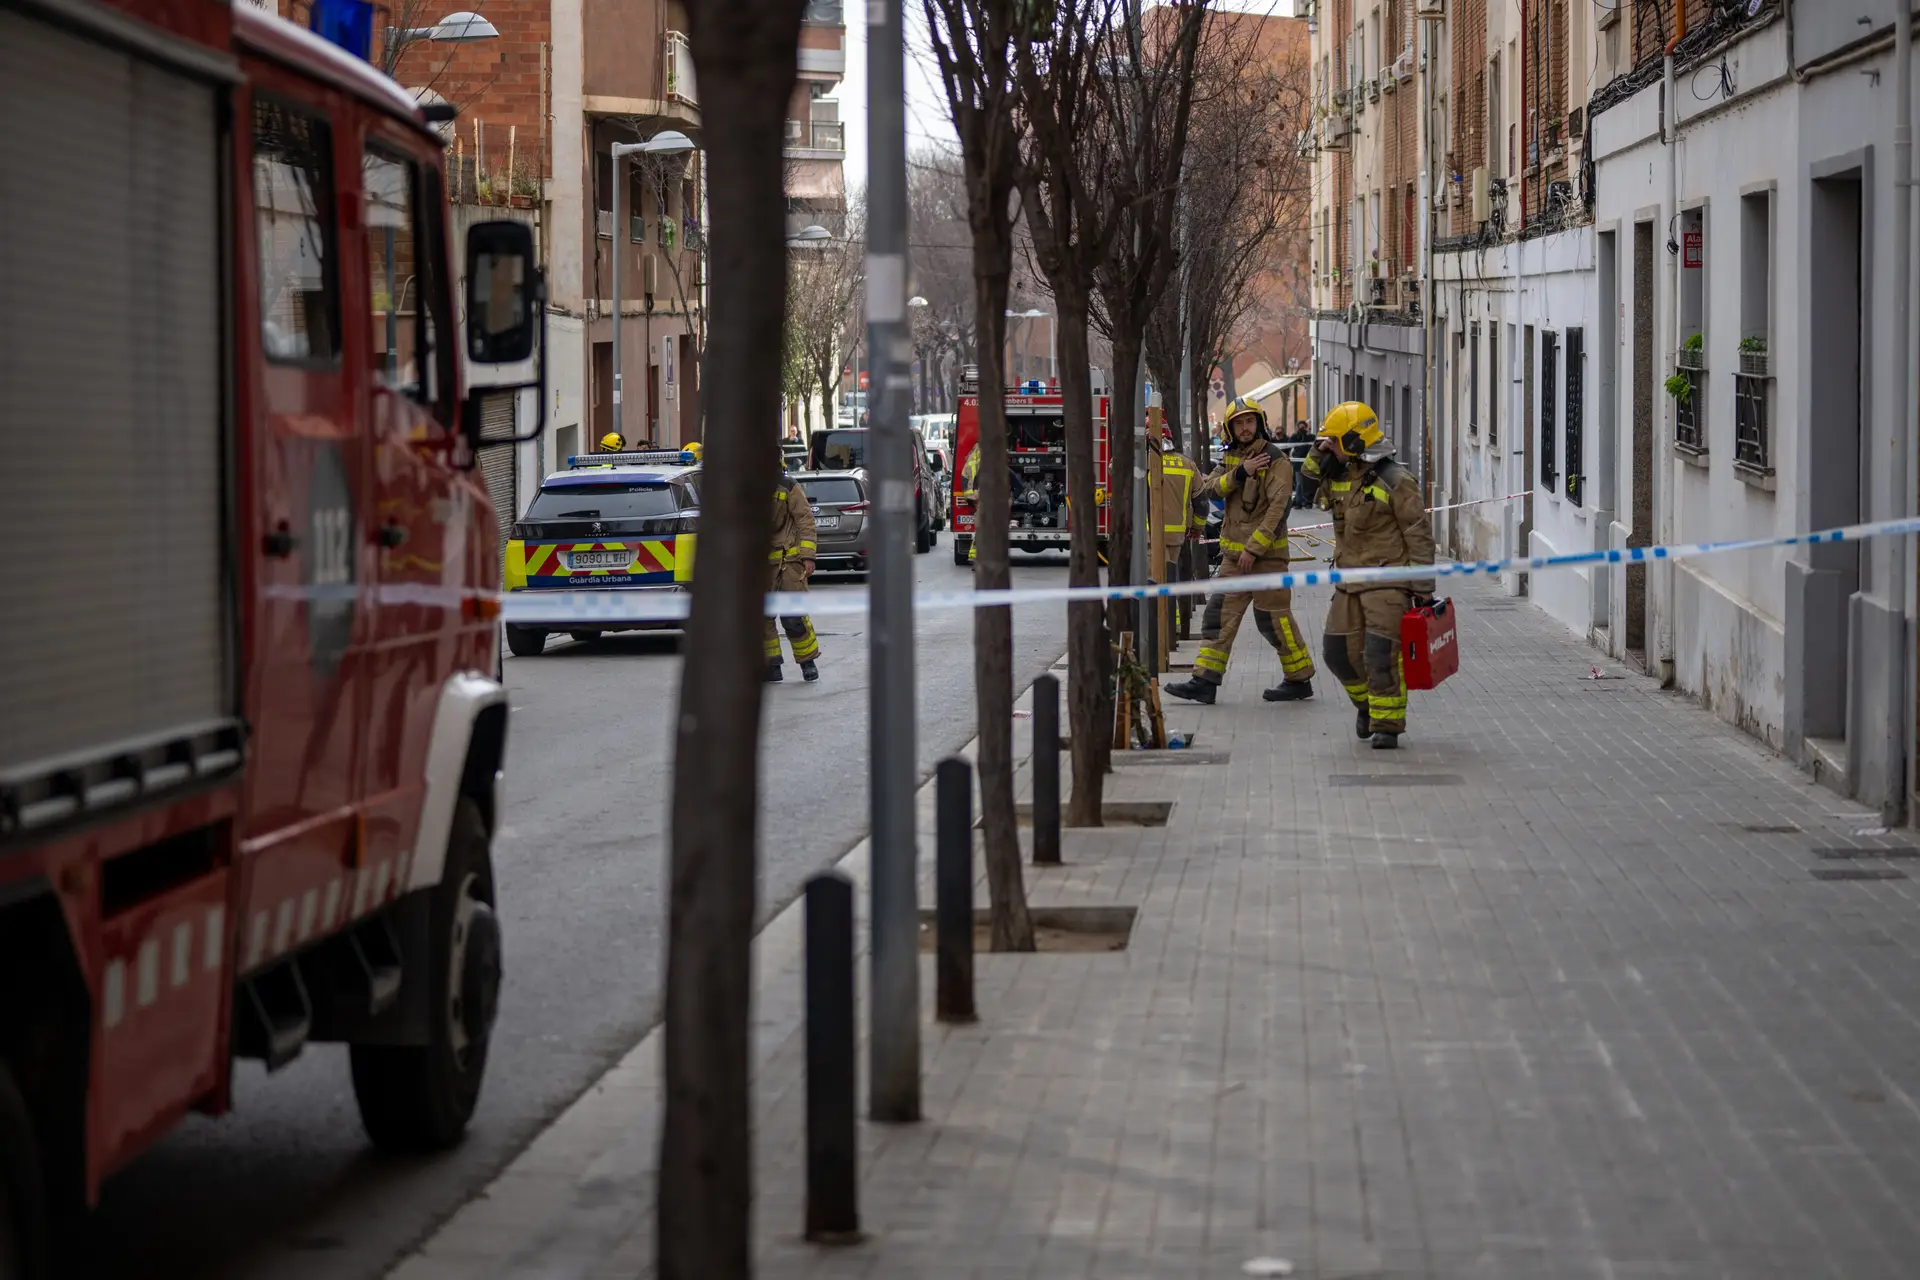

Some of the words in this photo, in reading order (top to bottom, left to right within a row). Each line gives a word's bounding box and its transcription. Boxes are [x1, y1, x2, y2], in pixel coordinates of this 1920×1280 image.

[575, 553, 603, 565] 9090
[569, 575, 601, 584] Guàrdia
[601, 575, 632, 583] Urbana
[1430, 627, 1455, 655] HILTI
